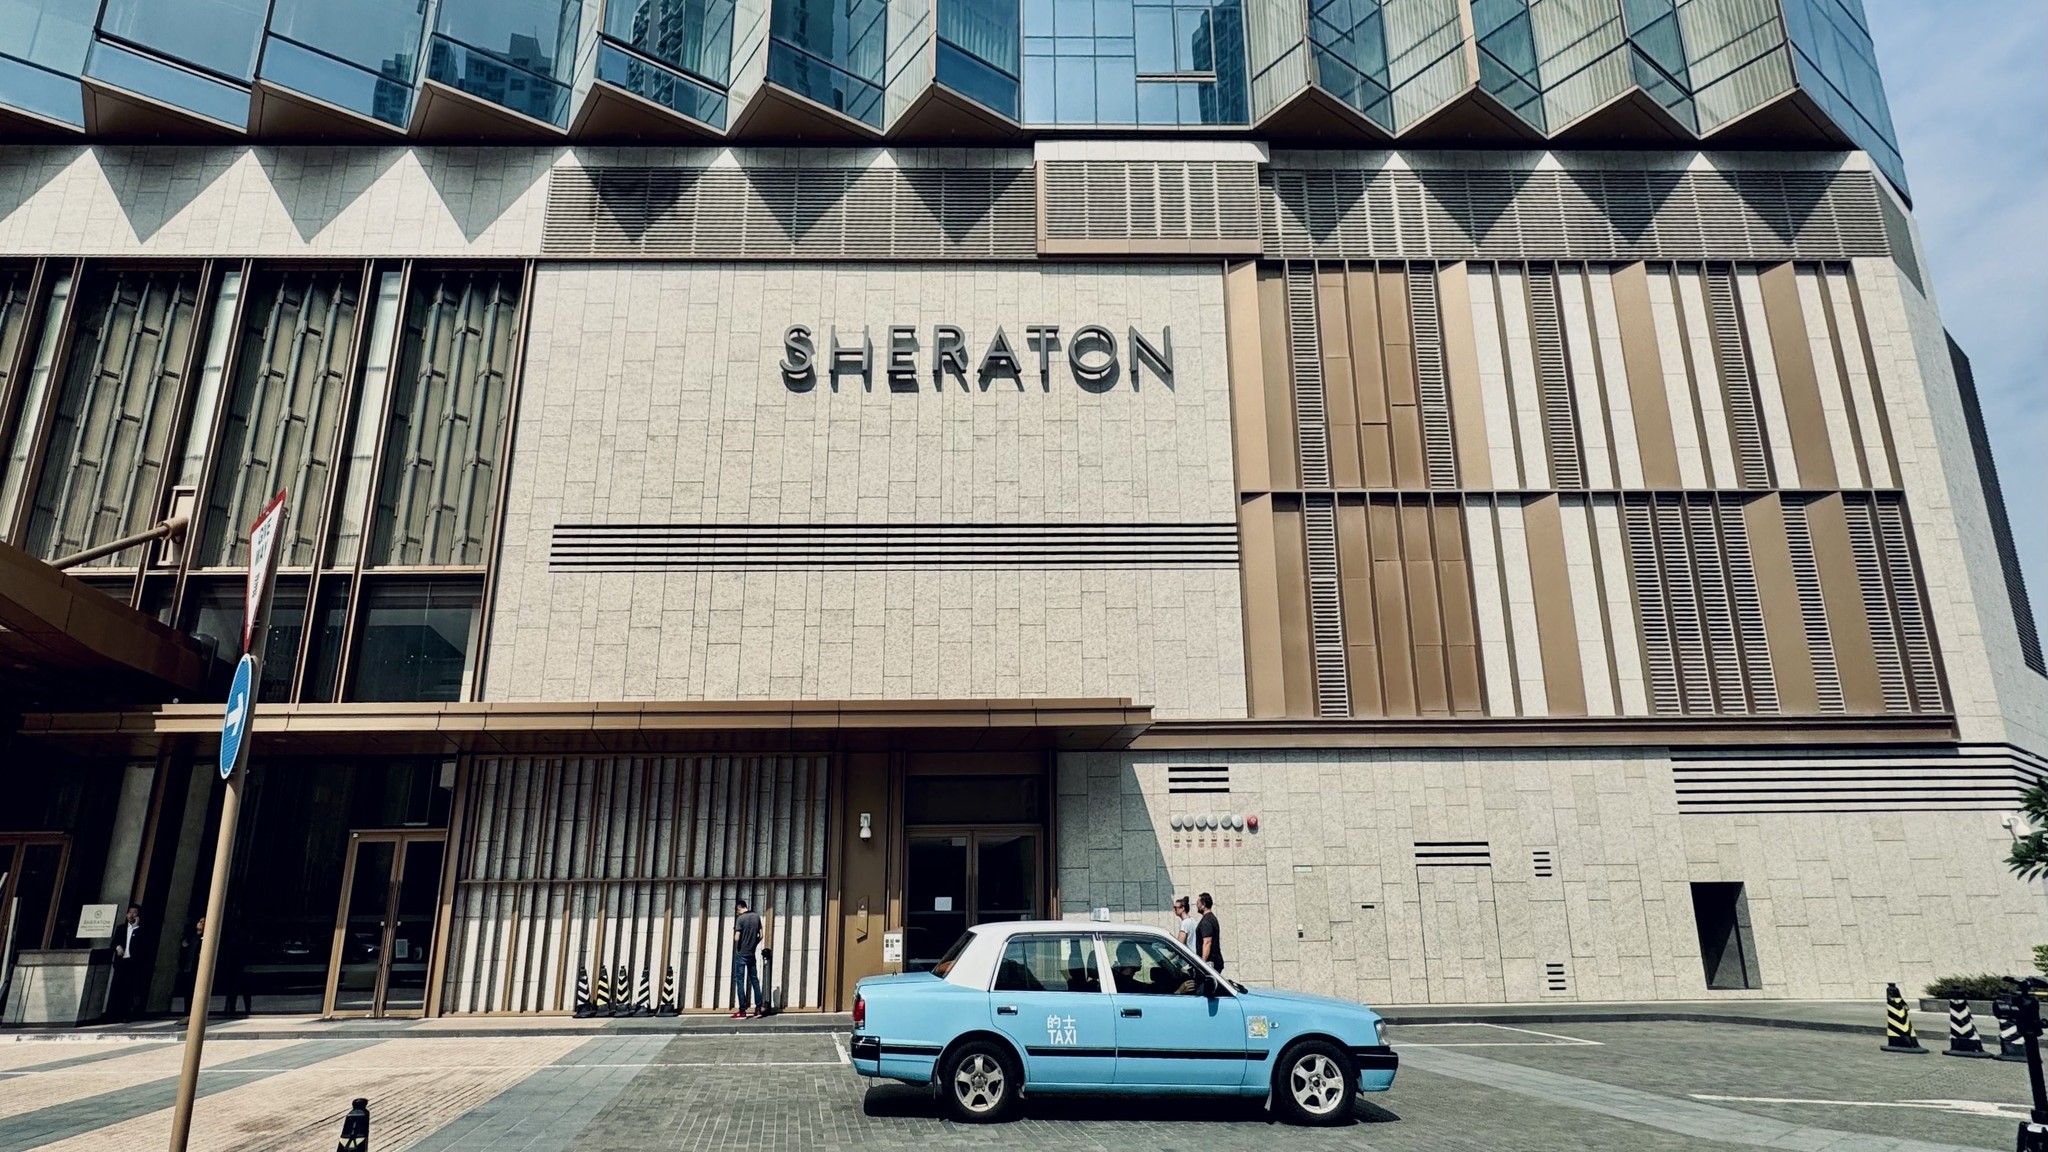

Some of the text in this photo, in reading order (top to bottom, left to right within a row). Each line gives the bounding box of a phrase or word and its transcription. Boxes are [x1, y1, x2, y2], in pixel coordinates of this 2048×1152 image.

[779, 323, 1174, 376] SHERATON
[1047, 1014, 1076, 1029] 的士
[1047, 1030, 1077, 1045] TAXI
